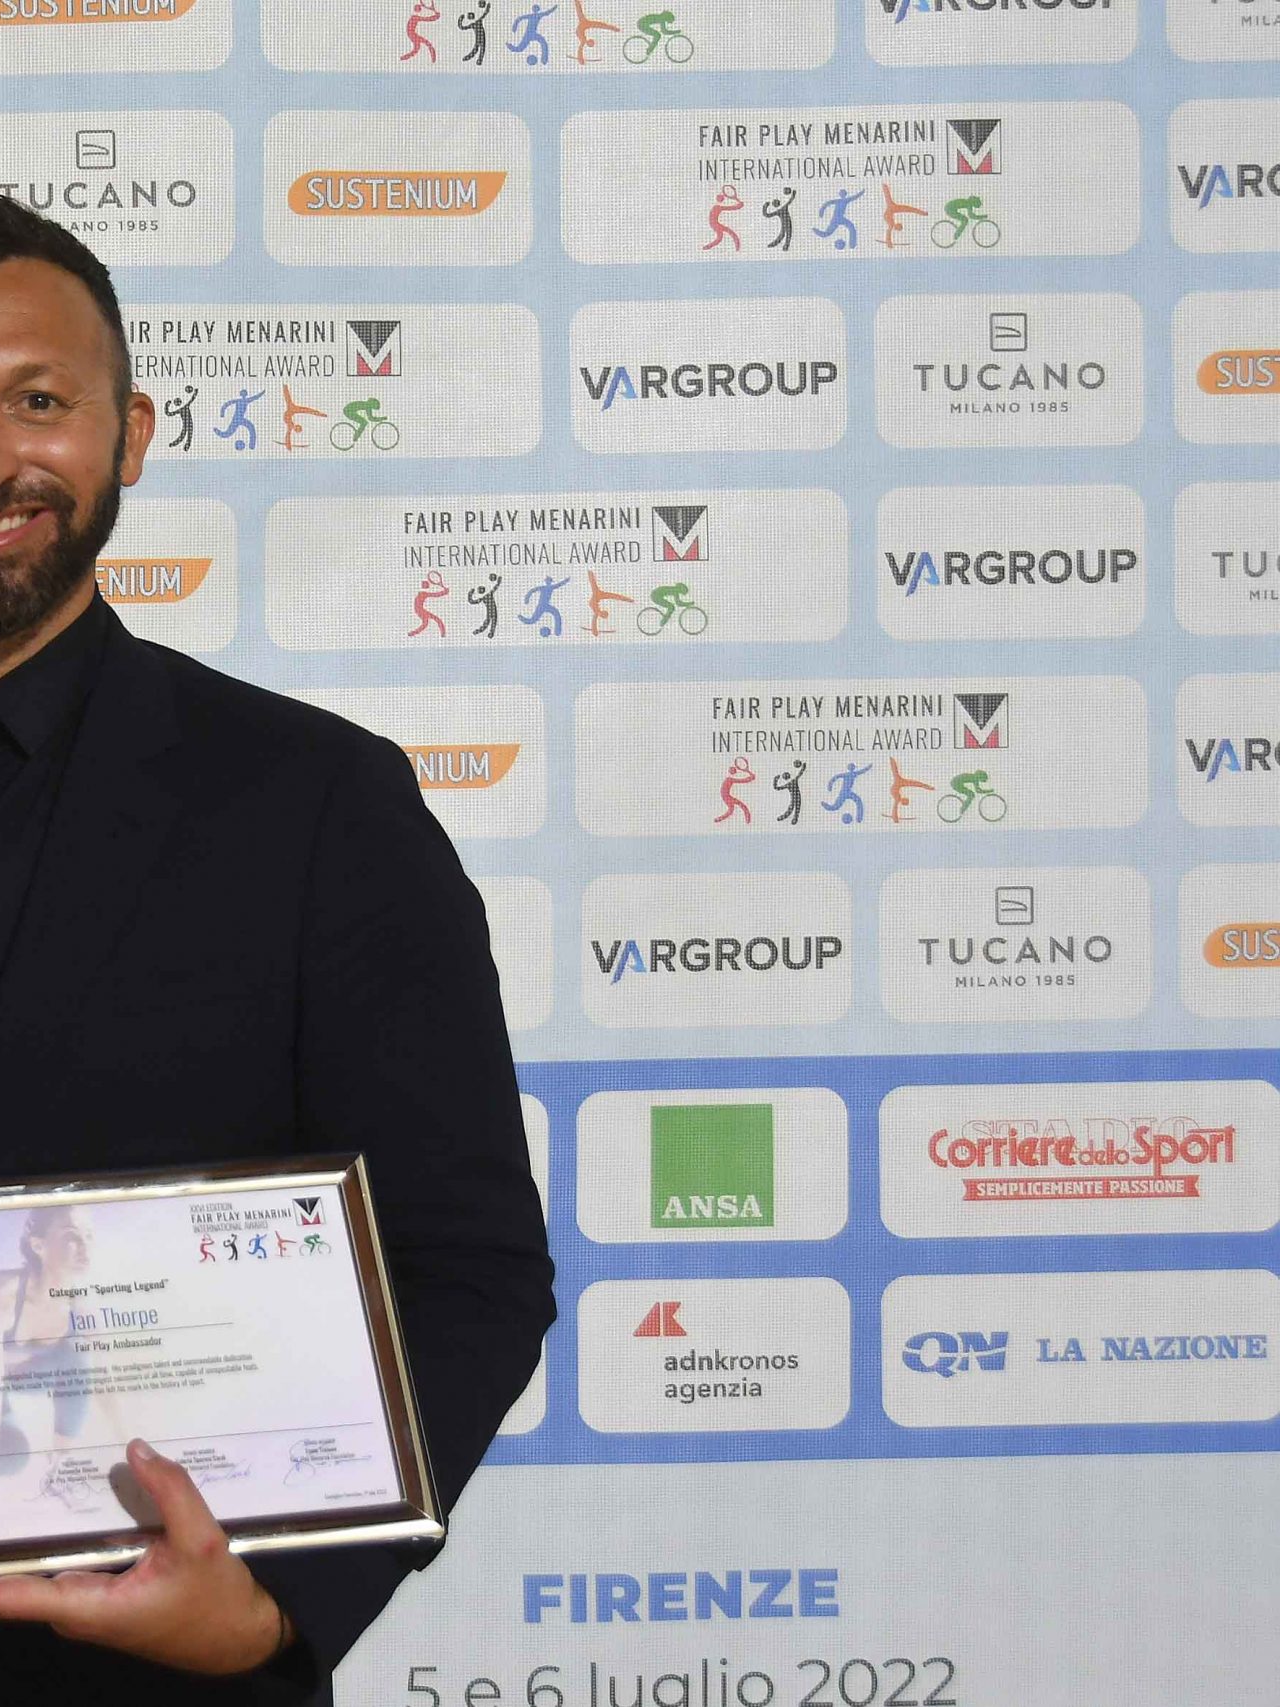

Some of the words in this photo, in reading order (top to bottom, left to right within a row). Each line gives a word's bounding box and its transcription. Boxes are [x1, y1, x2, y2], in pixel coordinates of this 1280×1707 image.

[699, 125, 747, 147] FAIR
[759, 124, 812, 146] PLAY
[825, 120, 935, 144] MENARINI
[699, 157, 856, 181] INTERNATIONAL
[863, 153, 936, 176] AWARD
[306, 178, 477, 211] SUSTENIUM
[63, 222, 107, 232] ANO
[119, 220, 159, 231] 1985
[163, 320, 215, 343] PLAY
[227, 320, 335, 343] MENARINI
[264, 355, 334, 377] AWARD
[913, 362, 1105, 392] TUCANO
[580, 361, 838, 410] VARGROUP
[950, 402, 1021, 414] MILANO
[1030, 401, 1068, 412] 1985
[404, 512, 452, 534] FAIR
[465, 510, 518, 533] PLAY
[530, 508, 640, 531] MENARINI
[404, 543, 562, 568] INTERNATIONAL
[569, 541, 641, 564] AWARD
[1211, 551, 1280, 578] TU
[886, 549, 1137, 596] VARGROUP
[713, 697, 760, 719] FAIR
[772, 697, 823, 719] PLAY
[836, 695, 942, 718] MENARINI
[712, 729, 863, 755] INTERNATIONAL
[872, 728, 943, 750] AWARD
[1186, 738, 1280, 783] VAR
[591, 936, 842, 983] VARGROUP
[918, 935, 1113, 965] TUCANO
[955, 975, 1027, 988] MILANO
[1036, 975, 1075, 986] 1985
[929, 1128, 1075, 1168] Corriere
[1132, 1126, 1235, 1176] Sport
[976, 1180, 1102, 1196] SEMPLICEMENTE
[1109, 1179, 1185, 1198] PASSIONE
[191, 1213, 213, 1224] FAIR
[216, 1211, 240, 1222] PLAY
[244, 1208, 292, 1220] MENARINI
[661, 1196, 763, 1218] ANSA
[49, 1286, 88, 1299] Category
[71, 1310, 96, 1331] Ian
[100, 1308, 159, 1329] Thorpe
[75, 1341, 90, 1352] Fair
[93, 1341, 110, 1351] Play
[113, 1336, 161, 1351] Ambassador
[902, 1331, 1009, 1378] QN
[1036, 1338, 1087, 1362] LA
[1101, 1334, 1268, 1361] NAZIONE
[664, 1349, 799, 1373] adnkronos
[665, 1377, 762, 1404] agenzia
[523, 1568, 838, 1623] FIRENZE
[408, 1666, 441, 1707] 5
[464, 1677, 501, 1707] e
[527, 1666, 564, 1707] 6
[590, 1658, 773, 1707] luglio
[798, 1657, 957, 1707] 2022
